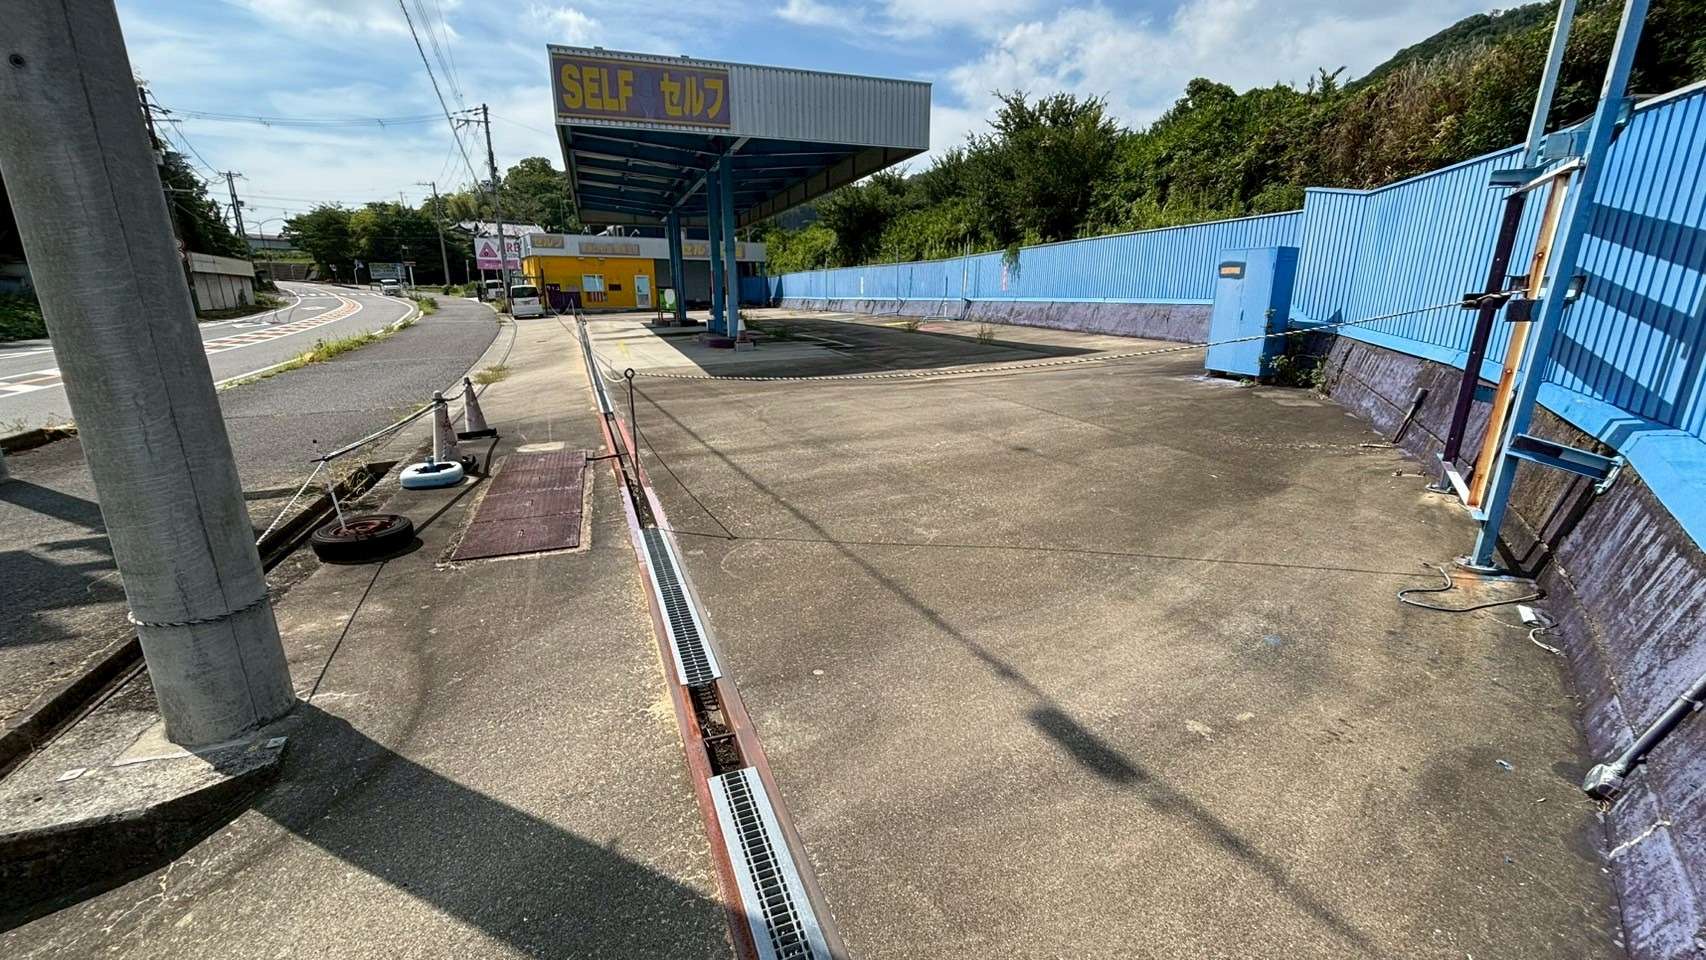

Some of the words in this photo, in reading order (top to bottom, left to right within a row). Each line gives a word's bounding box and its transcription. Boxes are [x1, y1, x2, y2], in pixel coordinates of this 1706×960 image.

[560, 64, 634, 111] SELF
[660, 72, 724, 119] セルフ
